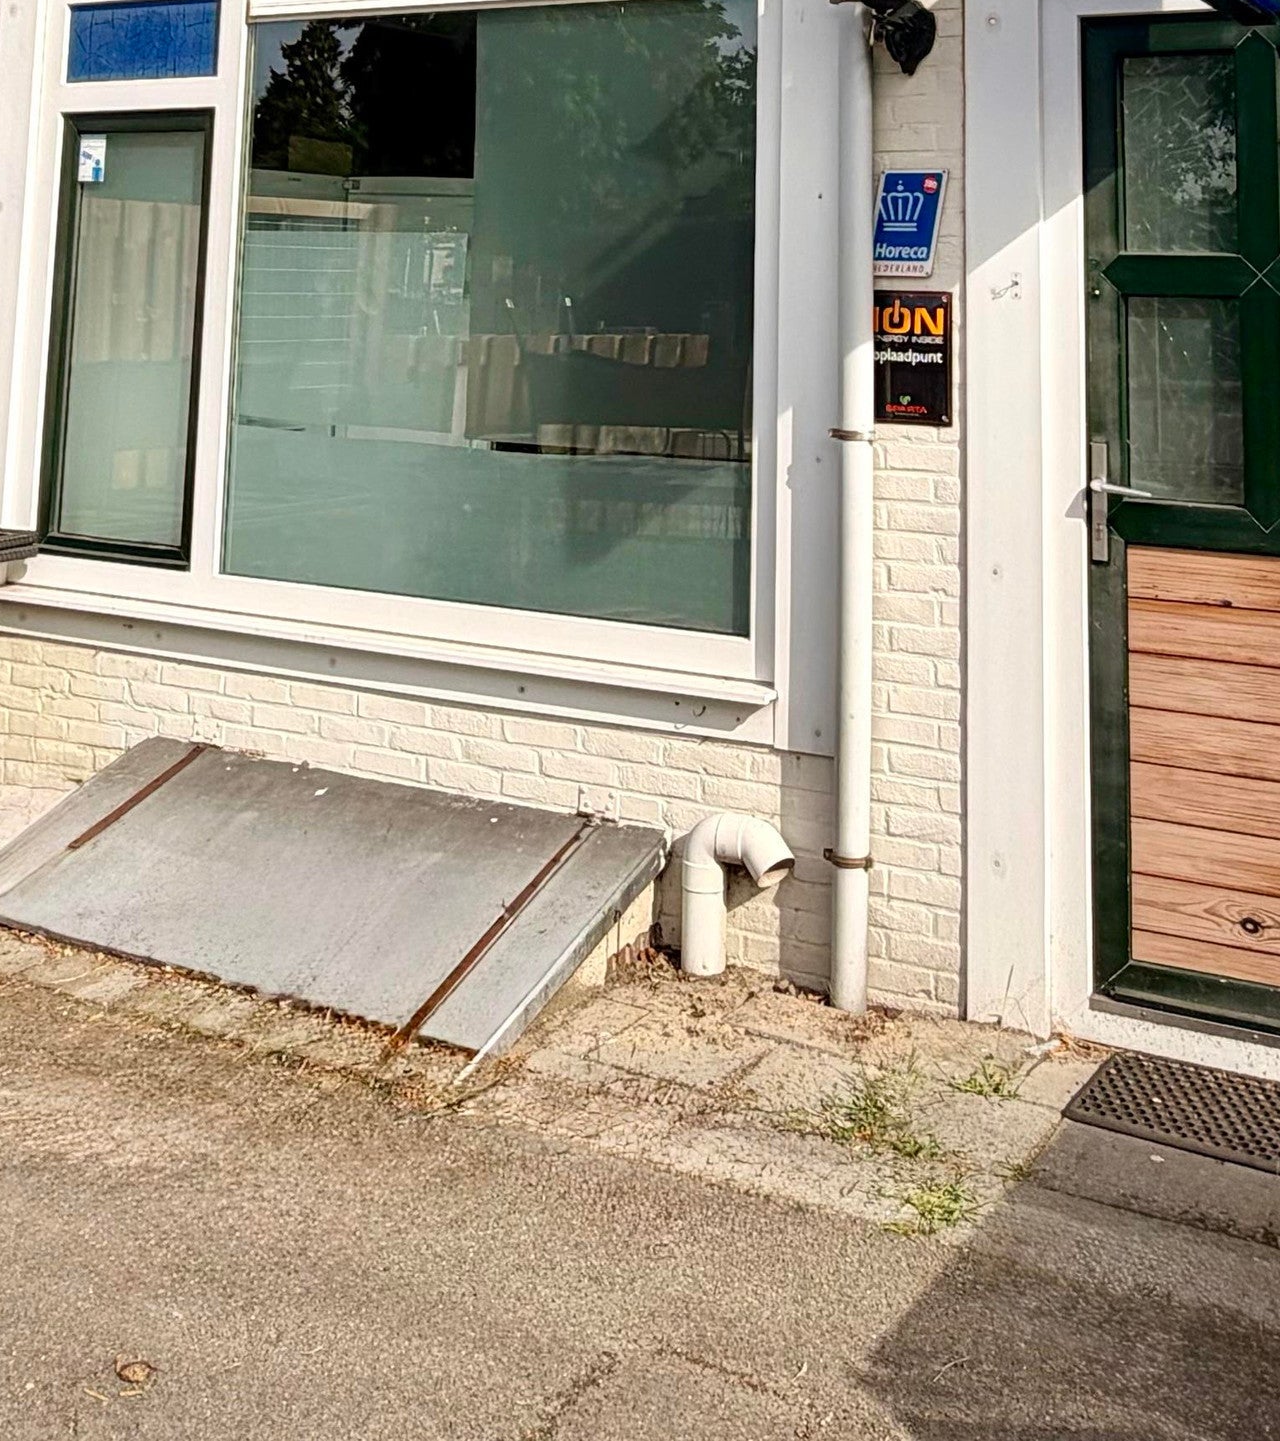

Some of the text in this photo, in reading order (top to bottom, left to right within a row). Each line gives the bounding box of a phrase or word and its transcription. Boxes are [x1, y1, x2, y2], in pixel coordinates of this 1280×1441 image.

[875, 242, 928, 259] Horeca
[872, 299, 945, 336] ION
[873, 348, 944, 367] oplaadpunt
